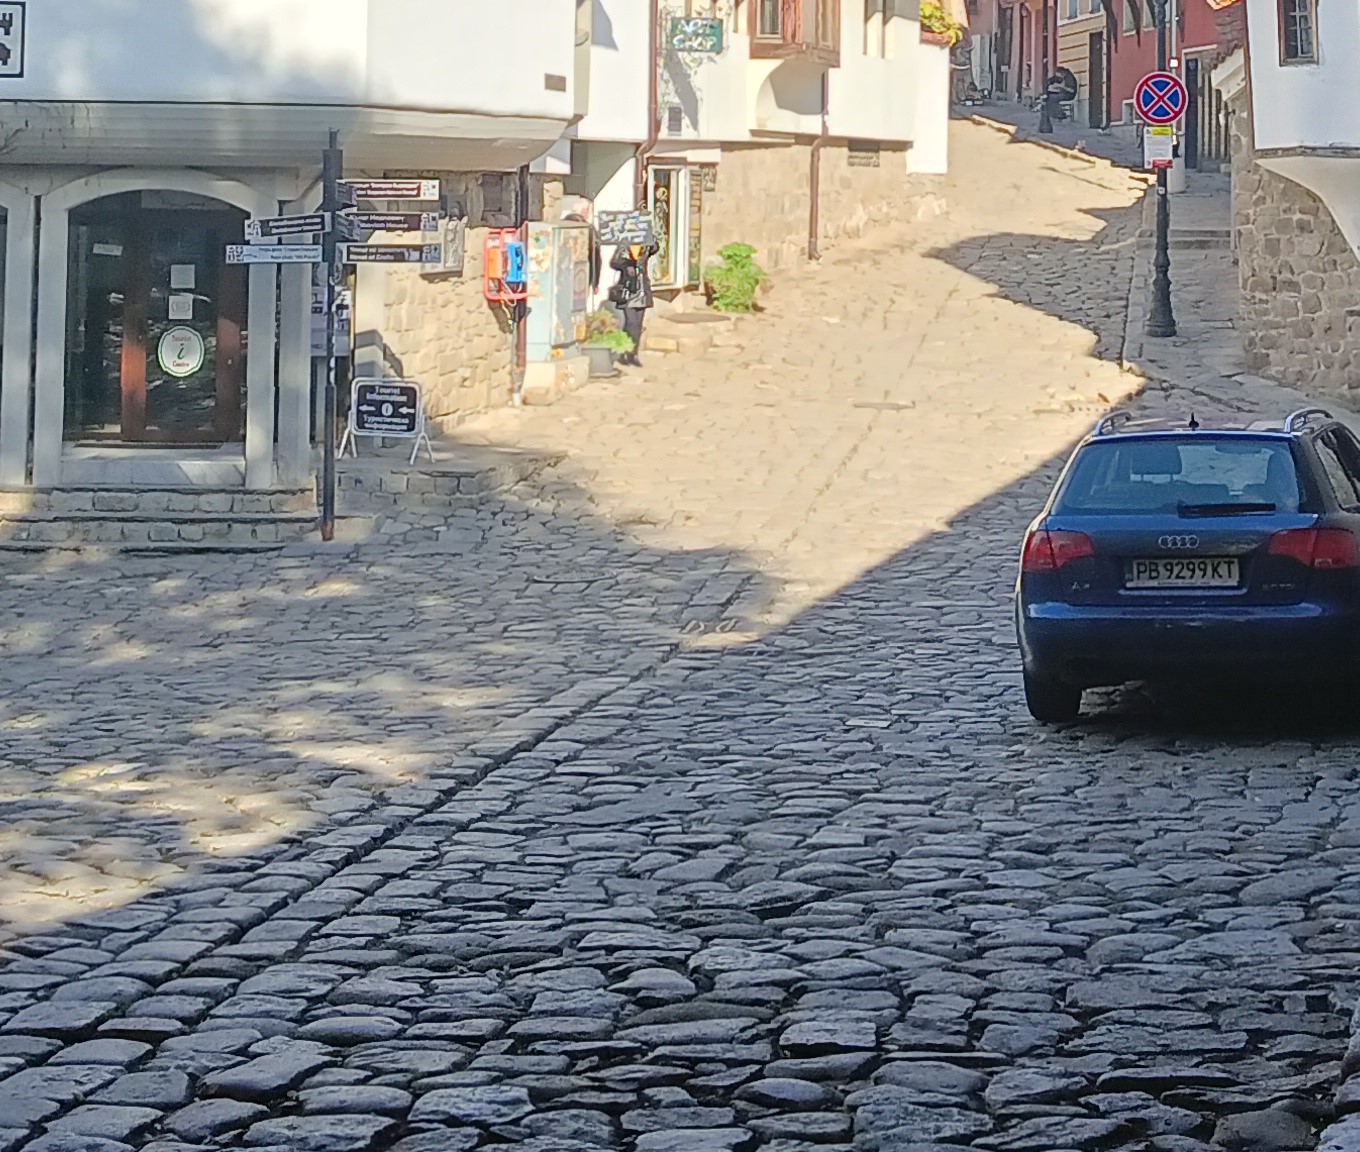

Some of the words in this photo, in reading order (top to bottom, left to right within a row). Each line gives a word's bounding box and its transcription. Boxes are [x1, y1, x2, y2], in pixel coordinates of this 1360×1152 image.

[1136, 561, 1160, 580] PB
[1164, 560, 1208, 579] 9299
[1211, 560, 1235, 579] KT
